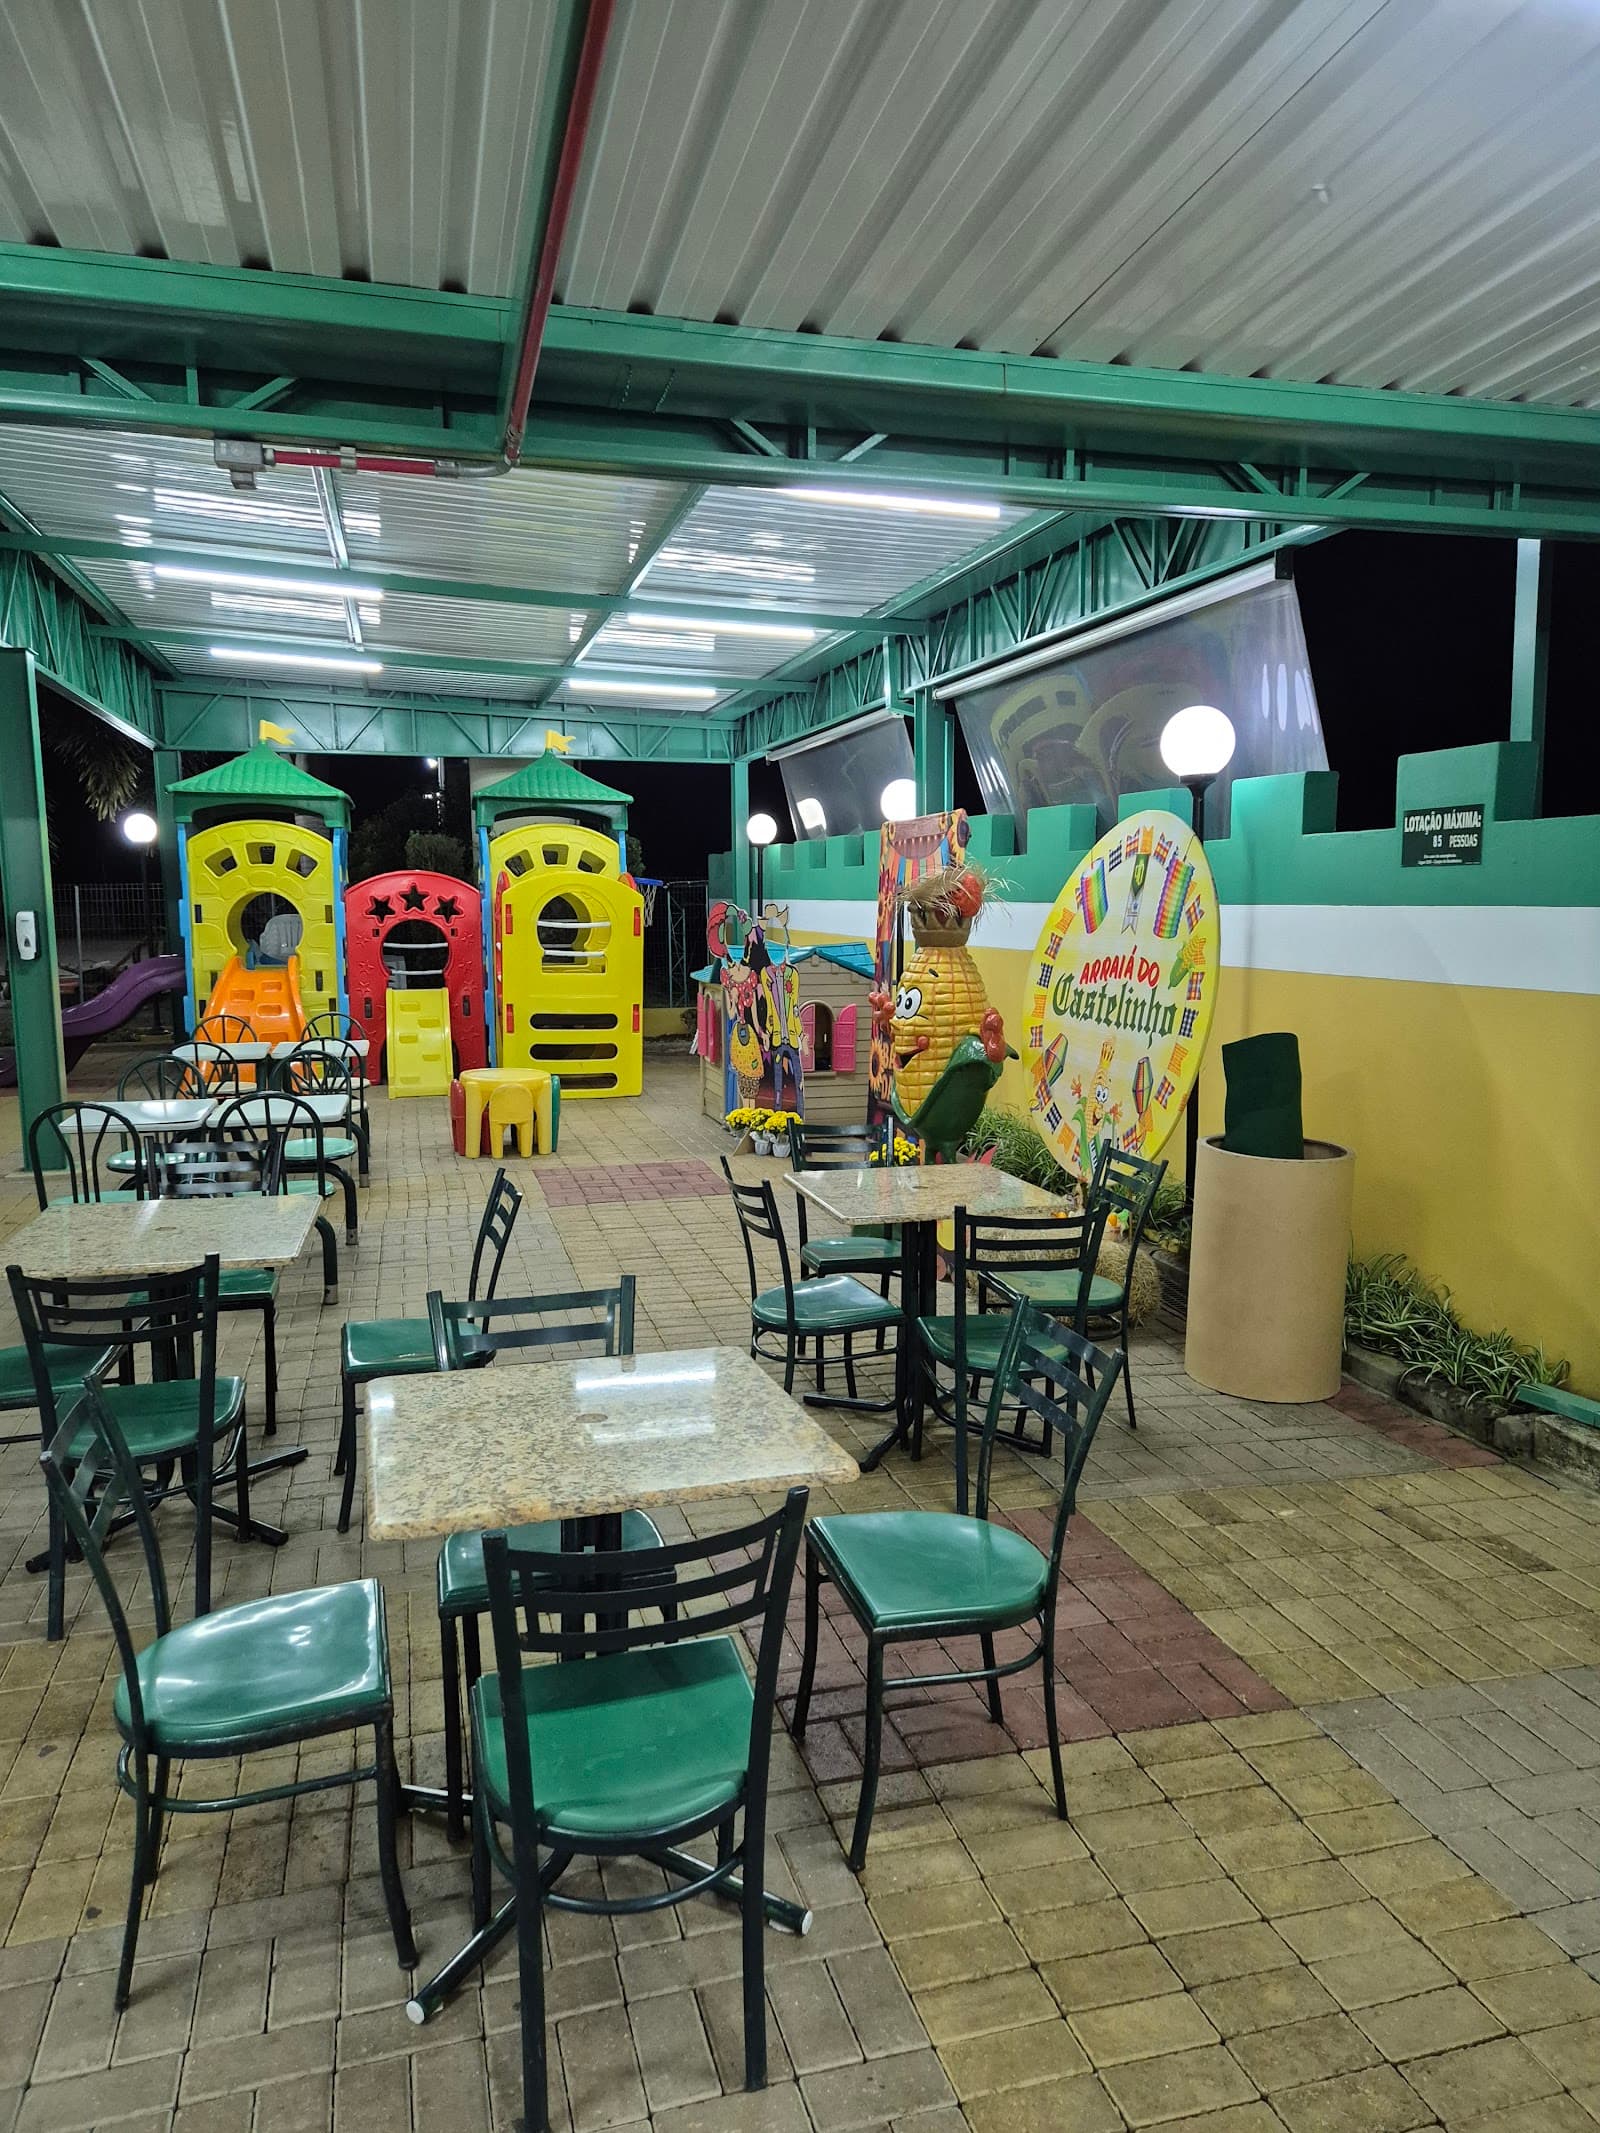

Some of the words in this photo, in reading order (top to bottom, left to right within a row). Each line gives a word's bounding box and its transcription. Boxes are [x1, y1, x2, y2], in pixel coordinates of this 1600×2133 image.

[1404, 811, 1442, 835] LOTAÇÃO
[1449, 834, 1478, 848] PESSOAS
[1079, 944, 1138, 985] ARRAIÁ
[1137, 957, 1160, 987] DO
[1052, 973, 1178, 1049] Castelinho
